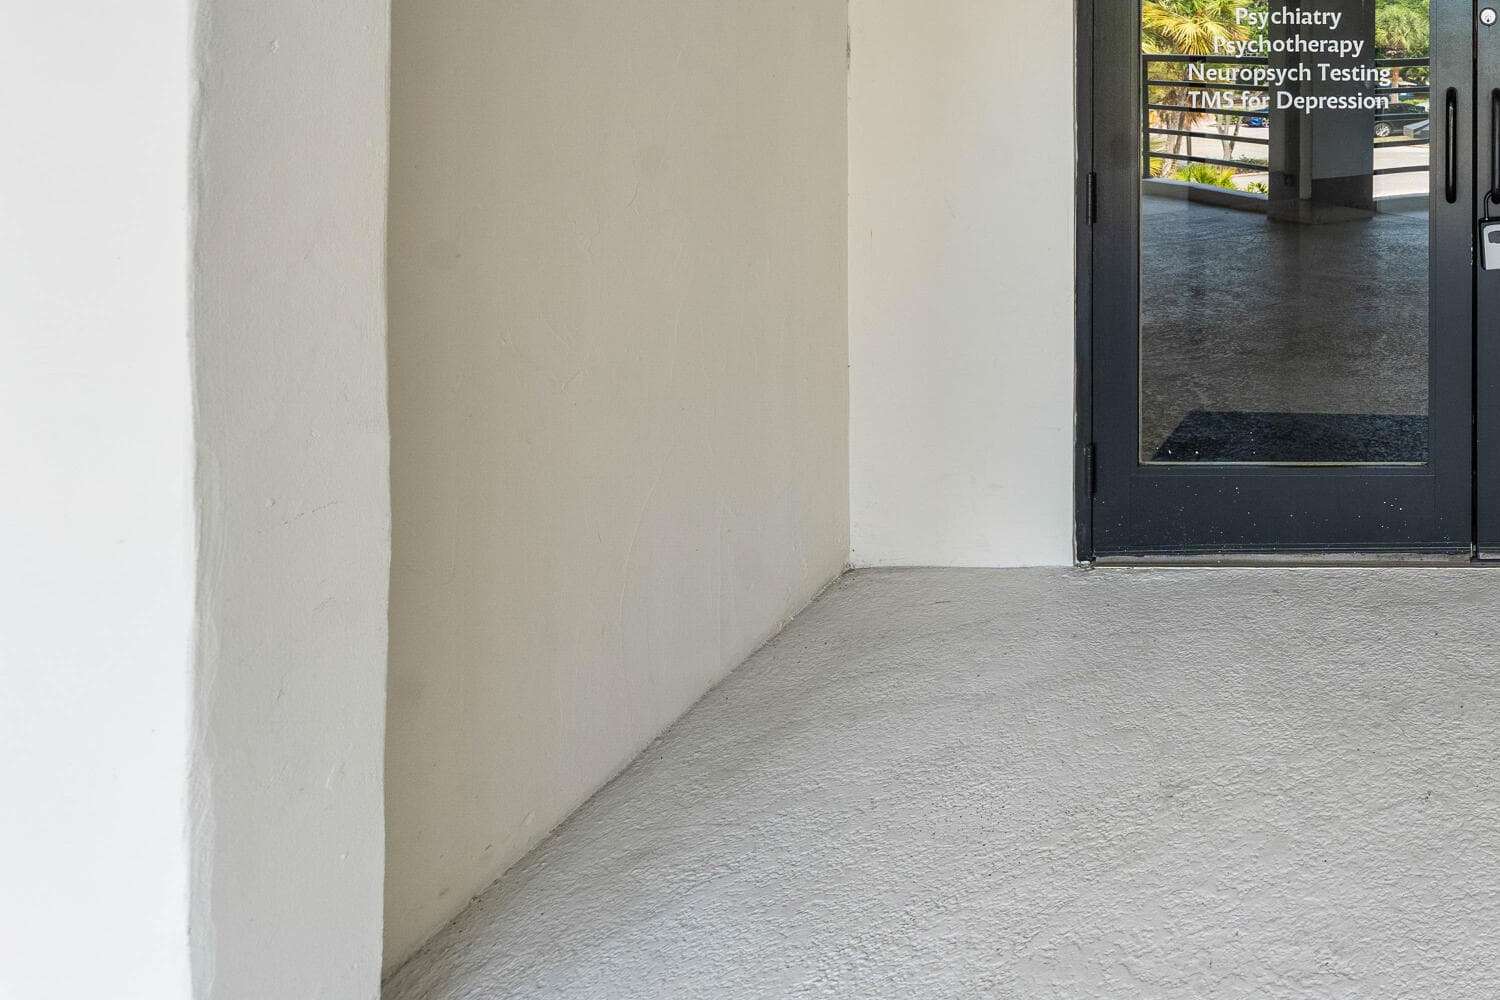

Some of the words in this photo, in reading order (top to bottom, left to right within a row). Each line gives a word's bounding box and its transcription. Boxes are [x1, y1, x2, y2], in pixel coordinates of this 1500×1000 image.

[1235, 6, 1342, 29] Psychiatry
[1214, 34, 1364, 57] Psychotherapy
[1188, 62, 1311, 86] Neuropsych
[1317, 62, 1391, 86] Testing
[1188, 91, 1234, 109] TMS
[1240, 90, 1269, 109] for
[1277, 91, 1390, 114] Depression
